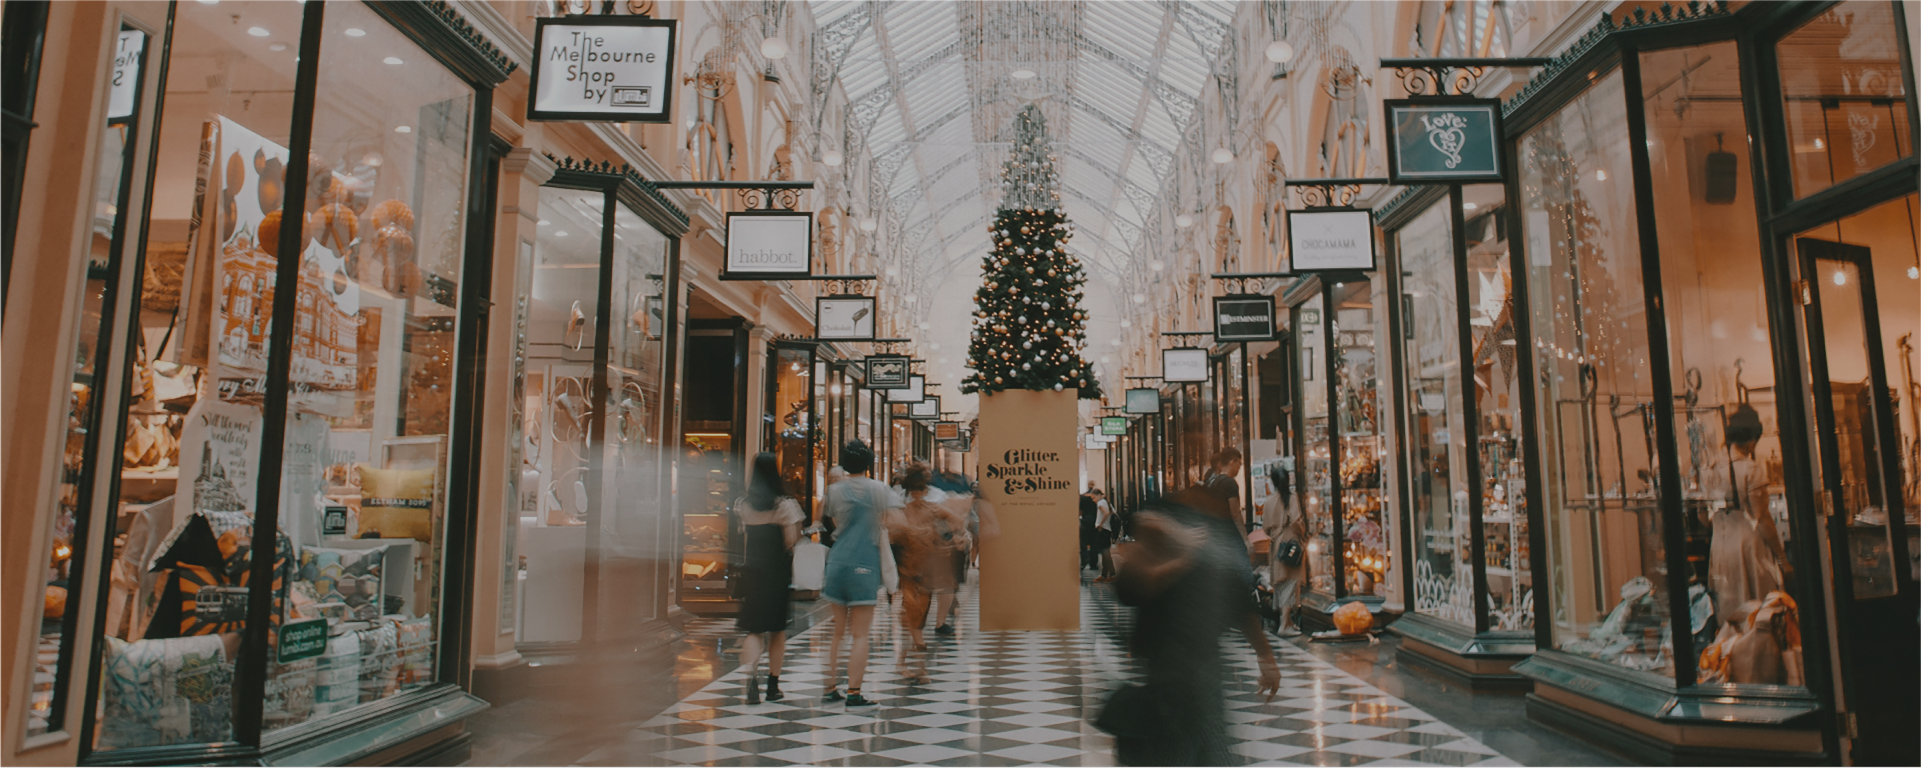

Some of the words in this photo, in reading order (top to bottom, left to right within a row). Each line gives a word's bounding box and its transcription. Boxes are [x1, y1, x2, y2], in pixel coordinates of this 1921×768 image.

[571, 31, 604, 47] The
[550, 45, 656, 63] Melbourne
[566, 64, 615, 86] Shop
[583, 85, 607, 104] by
[1301, 239, 1357, 250] CHOCAMAMA
[739, 249, 797, 264] habbot.
[1004, 448, 1060, 466] Glitter.
[986, 463, 1047, 480] Sparkle
[1024, 476, 1071, 494] Shine
